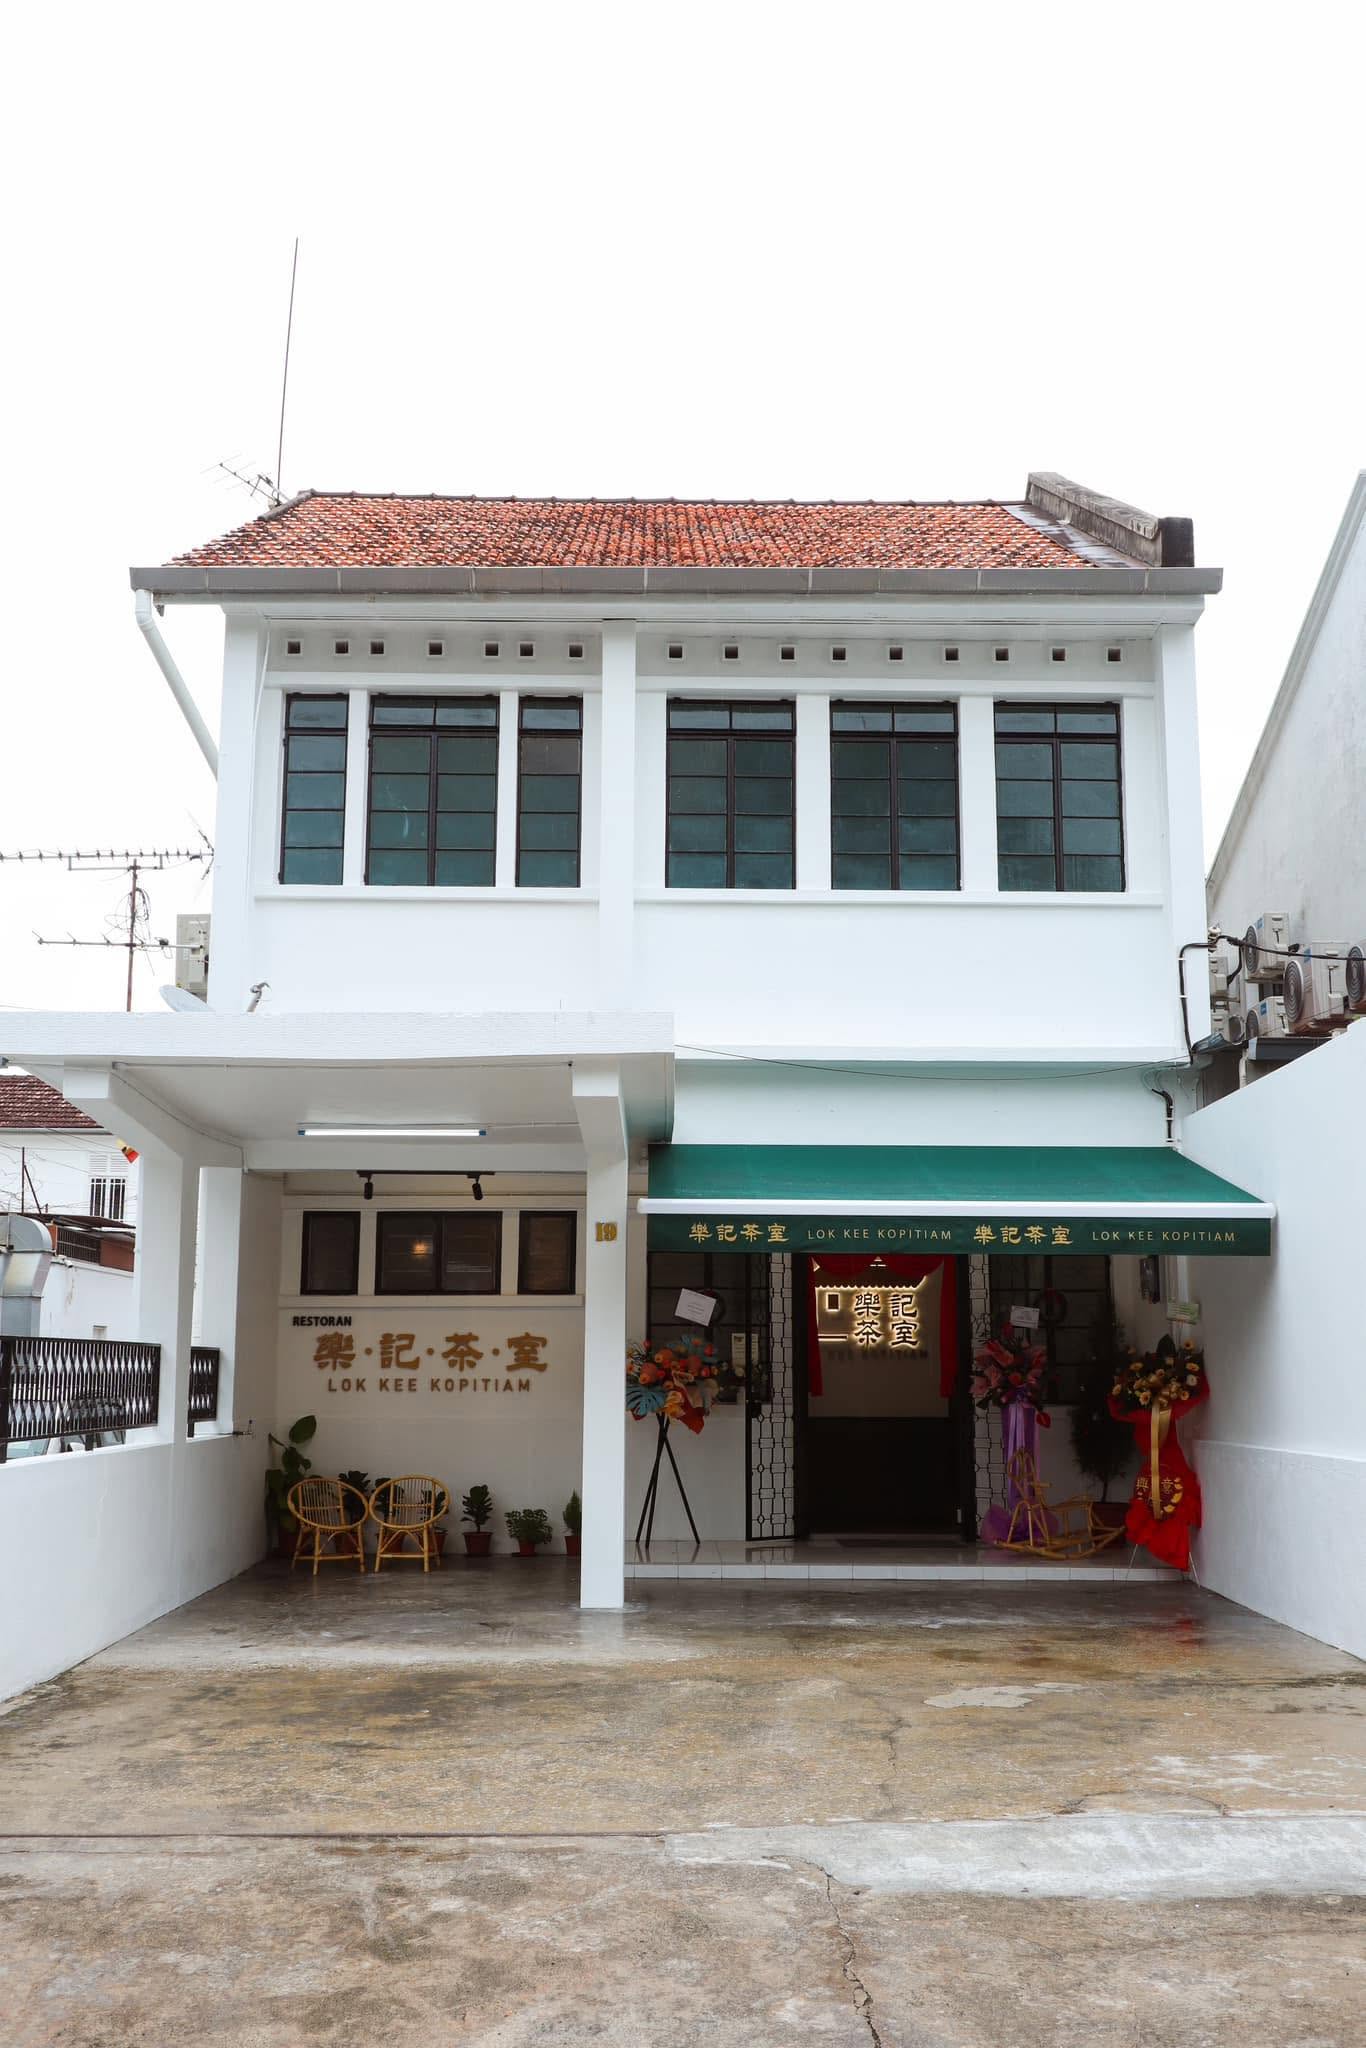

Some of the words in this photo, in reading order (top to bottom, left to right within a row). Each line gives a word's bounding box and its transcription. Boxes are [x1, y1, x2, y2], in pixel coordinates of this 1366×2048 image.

[595, 1221, 618, 1242] 19
[688, 1222, 790, 1244] 樂記茶室
[807, 1229, 836, 1240] LOK
[843, 1229, 870, 1240] KEE
[878, 1229, 952, 1241] KOPITIAM
[973, 1223, 1074, 1246] 樂記茶室
[1092, 1231, 1121, 1241] LOK
[1128, 1231, 1154, 1241] KEE
[1162, 1231, 1236, 1241] KOPITIAM
[292, 1316, 352, 1327] RESTORAN
[327, 1378, 367, 1392] LOK
[379, 1378, 417, 1393] KEE
[430, 1378, 531, 1393] KOPITIAM
